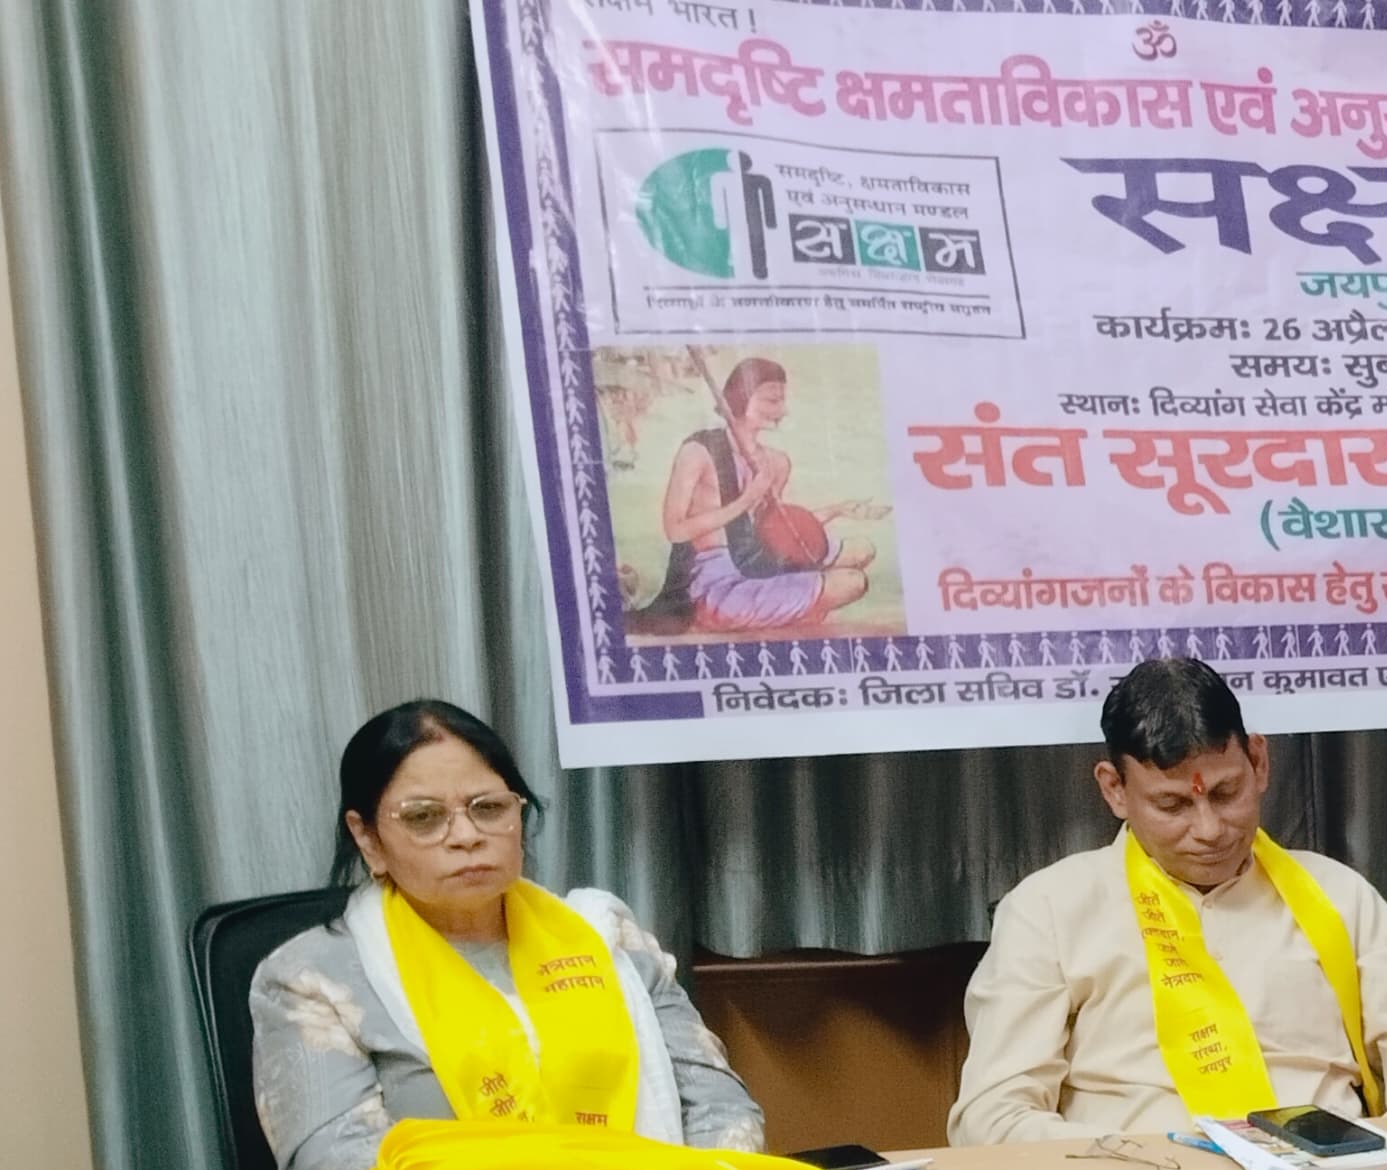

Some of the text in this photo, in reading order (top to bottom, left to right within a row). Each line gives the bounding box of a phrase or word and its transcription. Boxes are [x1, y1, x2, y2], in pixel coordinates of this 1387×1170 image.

[582, 38, 827, 127] समदृष्टि
[835, 55, 1193, 130] क्षमताविकास
[1200, 66, 1278, 136] एवं
[1263, 317, 1301, 341] 26
[1149, 387, 1247, 418] दिव्यांग
[1253, 388, 1308, 417] सेवा
[907, 401, 1087, 489] संत
[937, 563, 1149, 612] दिव्यांगजनों
[1158, 565, 1194, 604] के
[1202, 562, 1316, 607] विकास
[1323, 559, 1378, 614] हेतु
[857, 674, 945, 707] जिला
[955, 671, 1045, 703] सचिव
[1054, 668, 1100, 700] डॉ.
